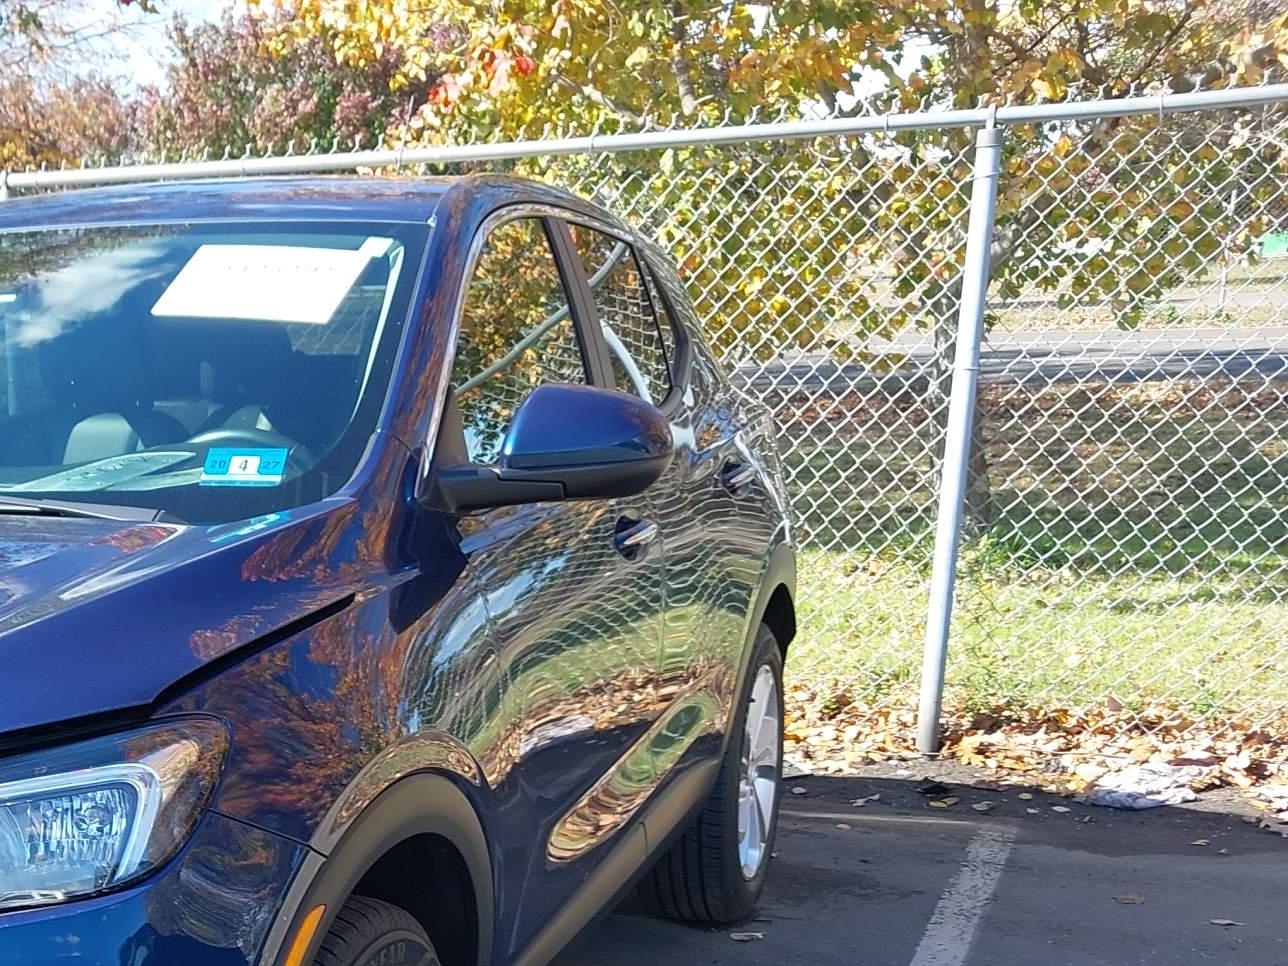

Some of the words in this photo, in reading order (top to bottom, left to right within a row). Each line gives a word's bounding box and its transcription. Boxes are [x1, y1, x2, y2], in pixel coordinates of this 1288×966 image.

[209, 460, 227, 469] 20
[238, 459, 249, 472] 4
[262, 461, 281, 470] 27
